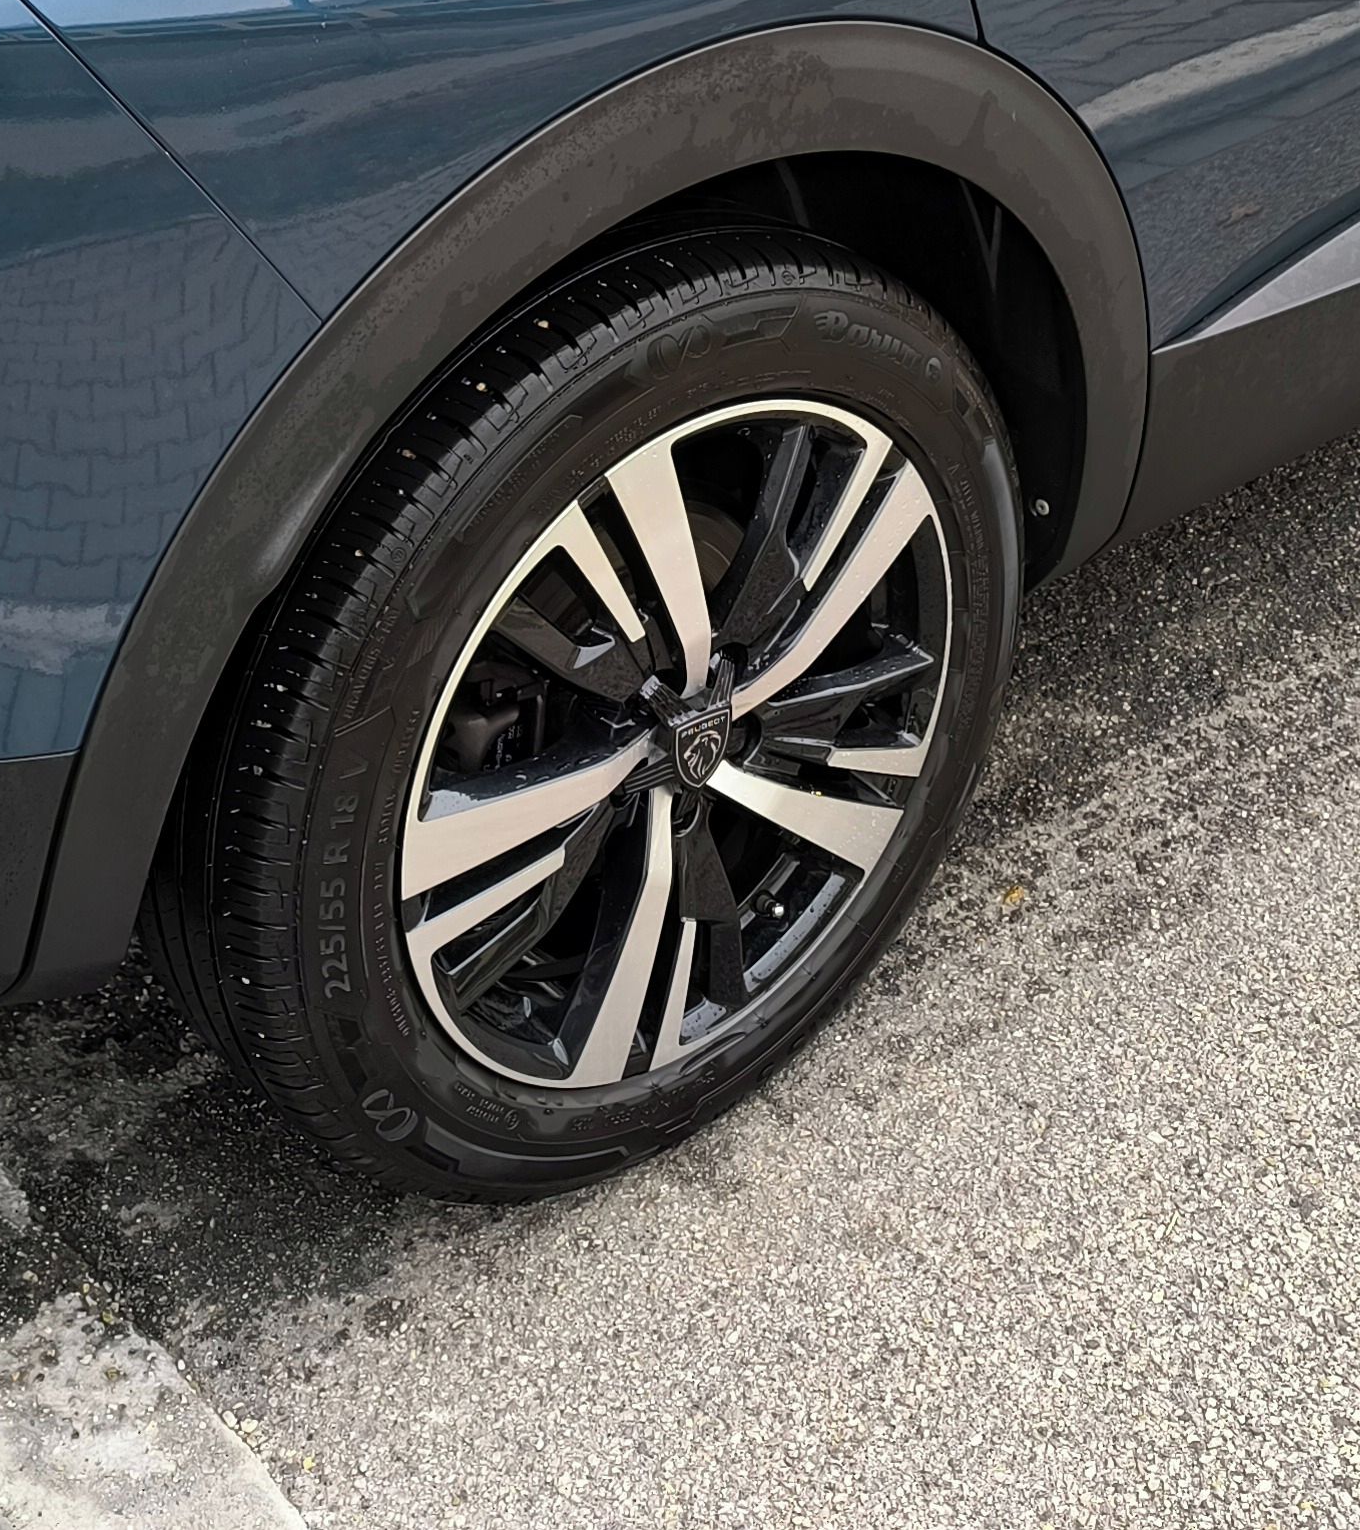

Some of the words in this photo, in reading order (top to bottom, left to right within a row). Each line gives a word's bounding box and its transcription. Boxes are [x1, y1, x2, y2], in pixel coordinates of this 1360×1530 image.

[813, 310, 925, 368] Barum
[681, 715, 726, 739] PEUGEOT
[329, 794, 359, 830] 18
[323, 837, 351, 865] R
[319, 877, 352, 1000] 225/55
